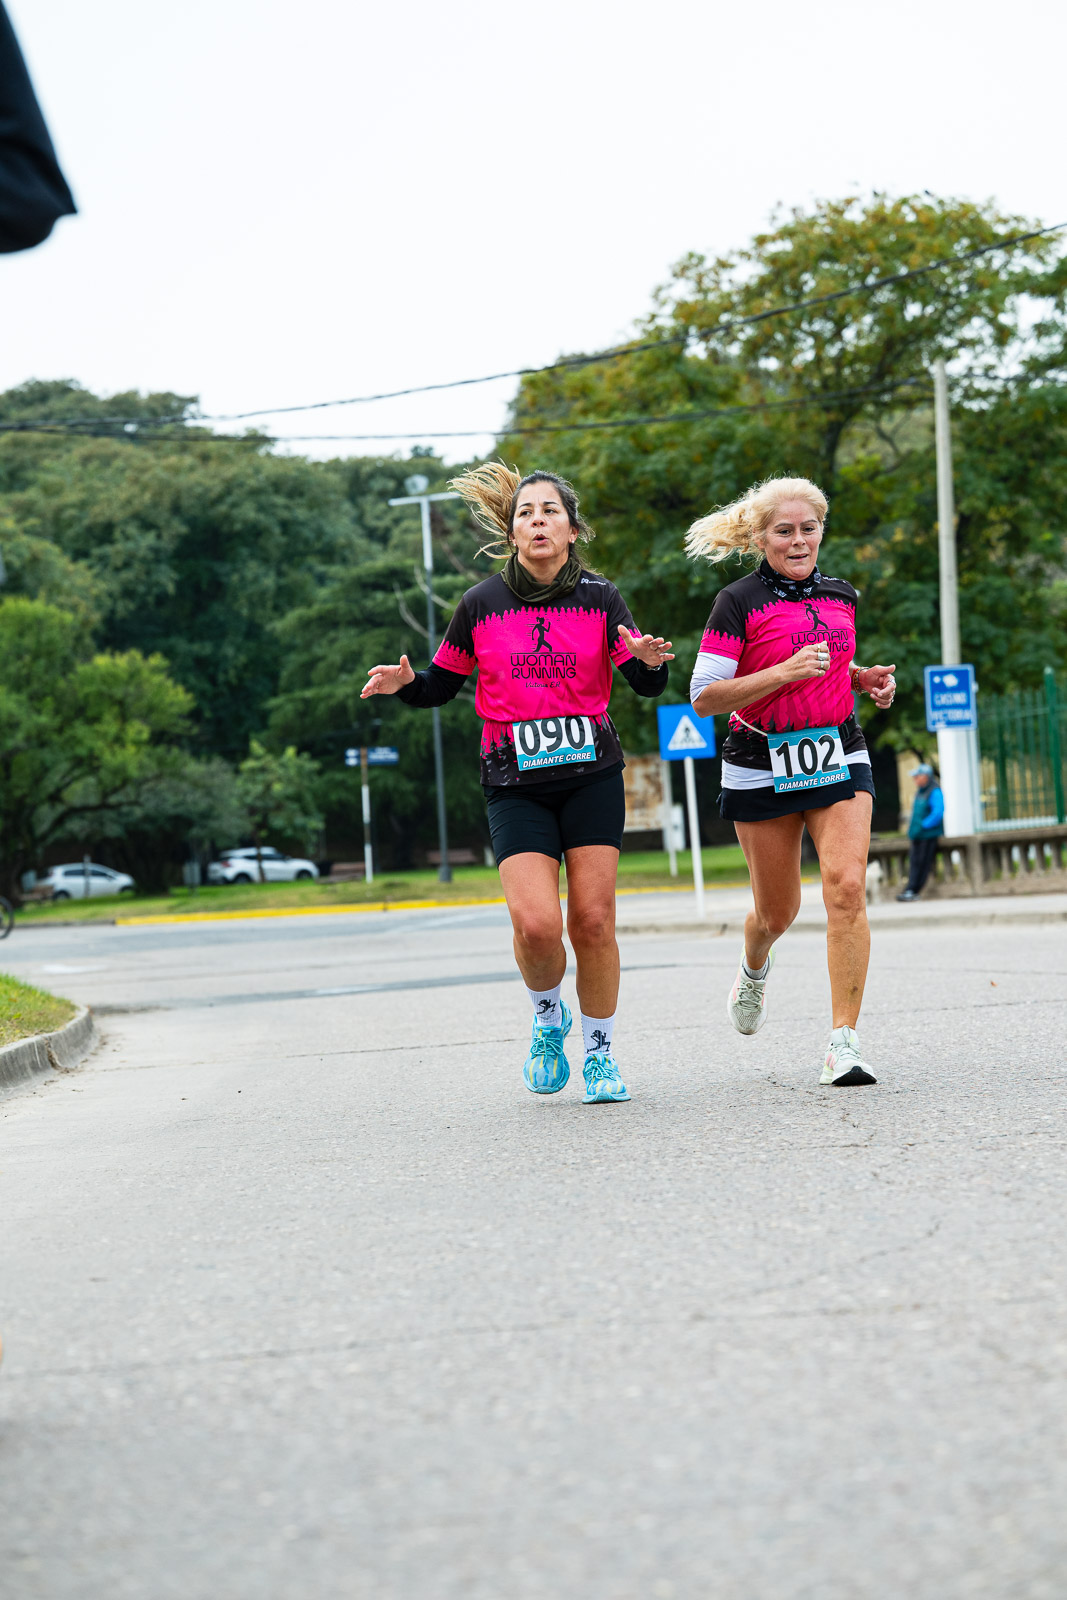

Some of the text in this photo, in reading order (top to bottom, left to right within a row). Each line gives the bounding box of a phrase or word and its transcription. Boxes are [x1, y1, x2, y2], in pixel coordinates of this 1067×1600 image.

[791, 630, 849, 646] WOMAN
[510, 654, 577, 667] WOMAN
[511, 666, 577, 679] RUNNING
[519, 716, 586, 757] 090
[522, 752, 592, 768] DIAMANTE CORRE
[775, 734, 841, 779] 102
[779, 772, 846, 791] DIAMANTE CORRE
